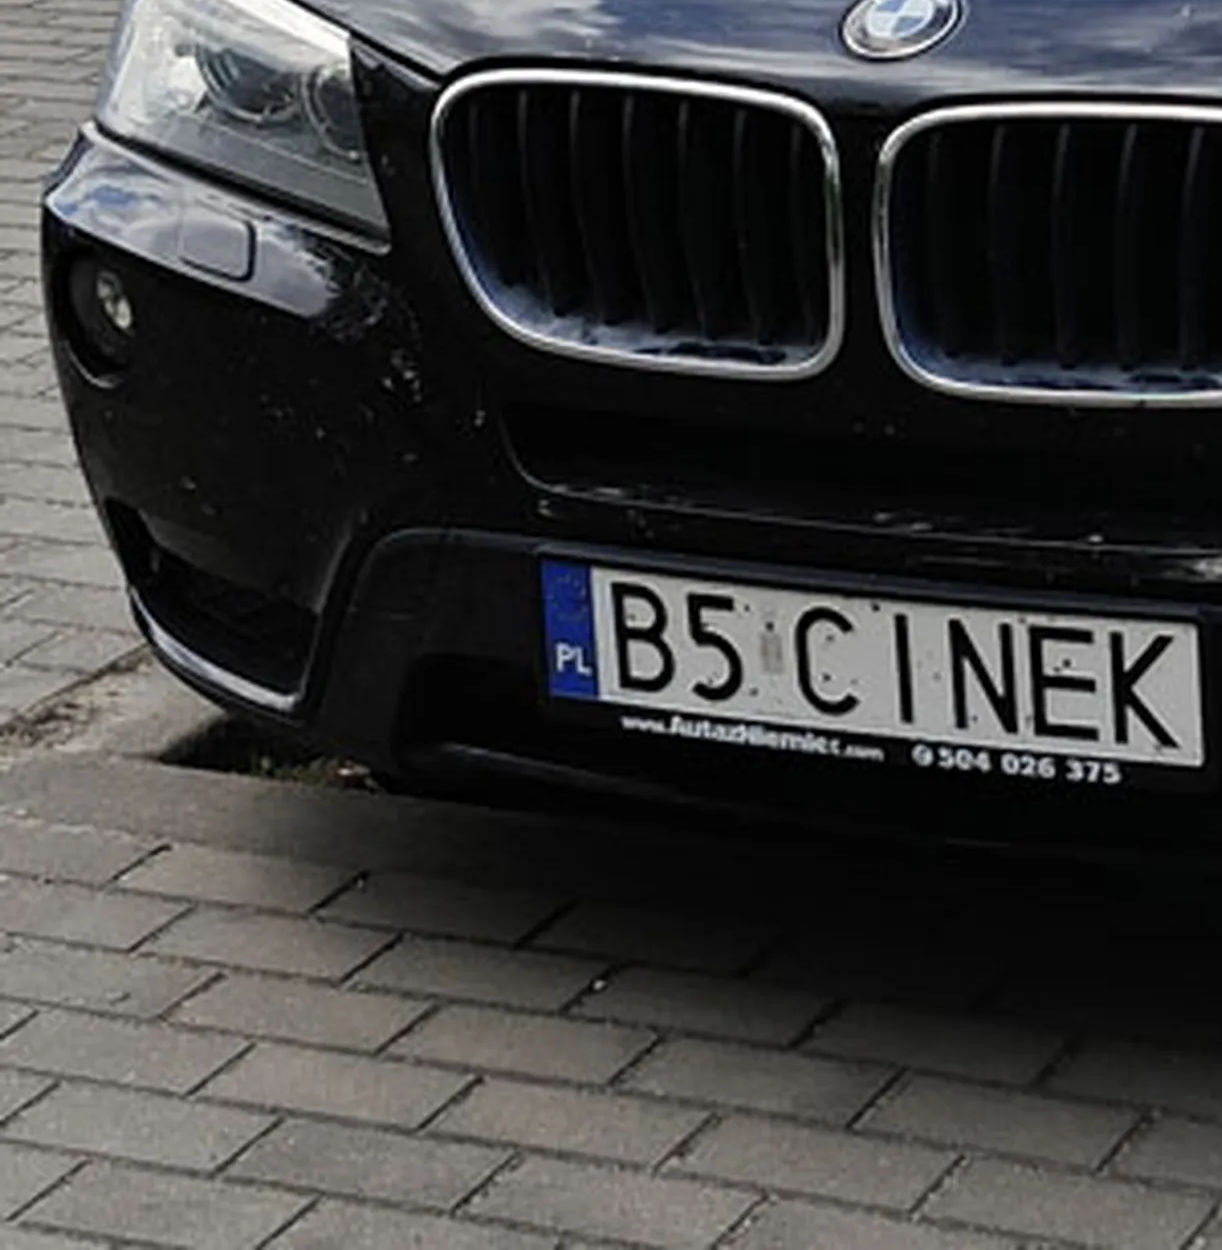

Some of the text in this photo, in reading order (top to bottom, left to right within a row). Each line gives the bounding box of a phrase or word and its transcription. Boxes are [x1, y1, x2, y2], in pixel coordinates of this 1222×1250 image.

[555, 642, 592, 676] PL
[610, 581, 1180, 749] B5 CINEK
[1001, 752, 1057, 780] 026
[1065, 758, 1123, 785] 375
